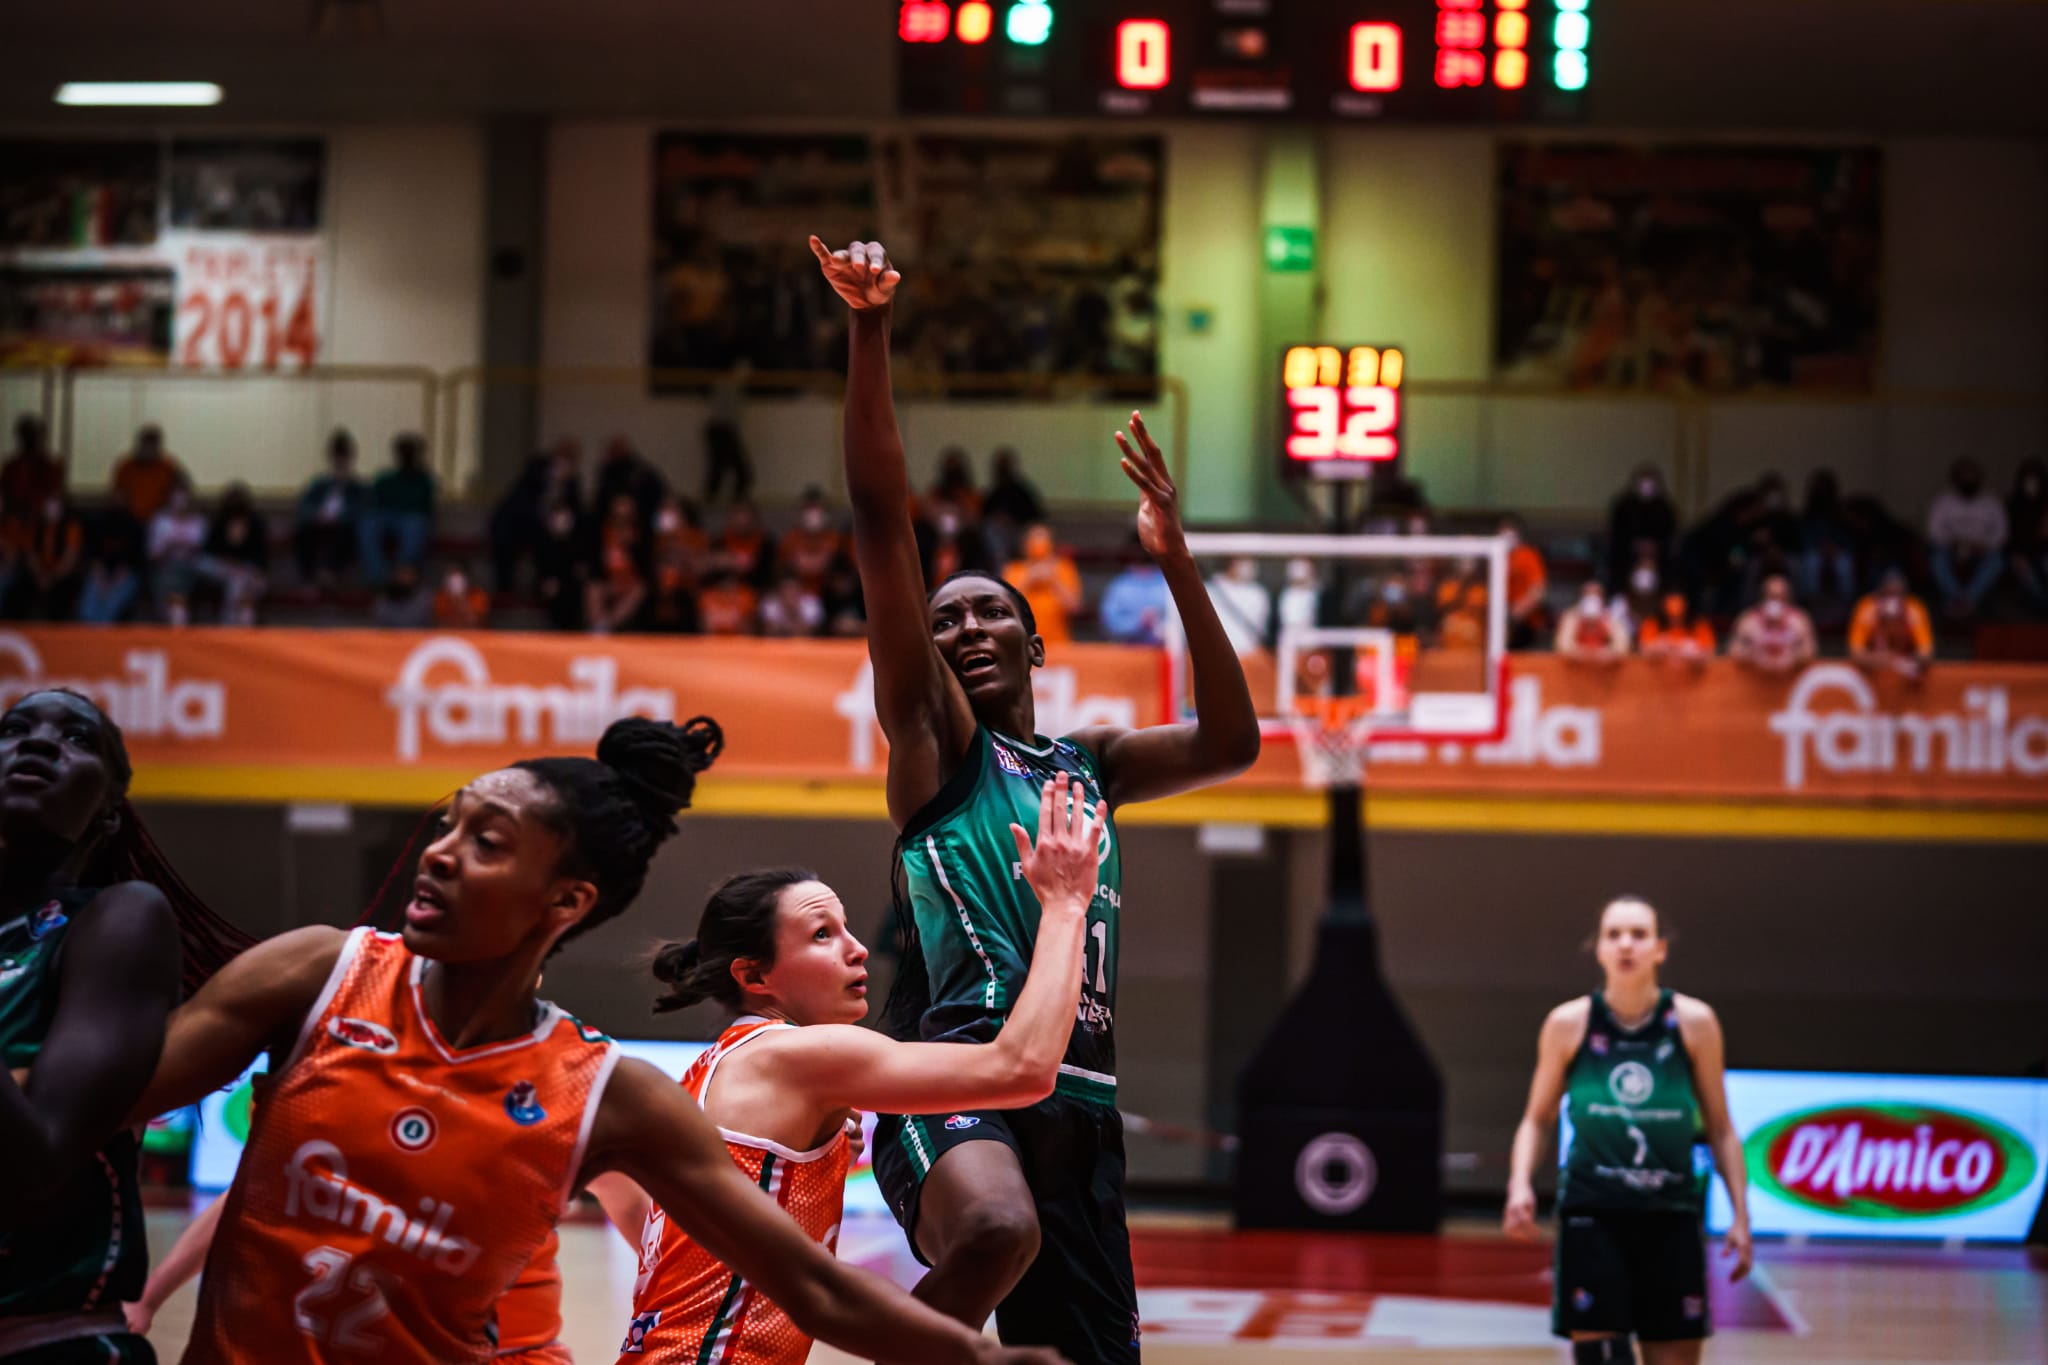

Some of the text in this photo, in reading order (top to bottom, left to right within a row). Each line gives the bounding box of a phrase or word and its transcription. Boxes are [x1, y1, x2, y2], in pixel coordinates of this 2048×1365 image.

[1115, 19, 1170, 90] 0
[1350, 21, 1402, 92] 0
[181, 262, 318, 369] 2014
[1778, 1122, 1995, 1198] D'Amico
[283, 1138, 482, 1278] famila
[293, 1244, 404, 1357] 22
